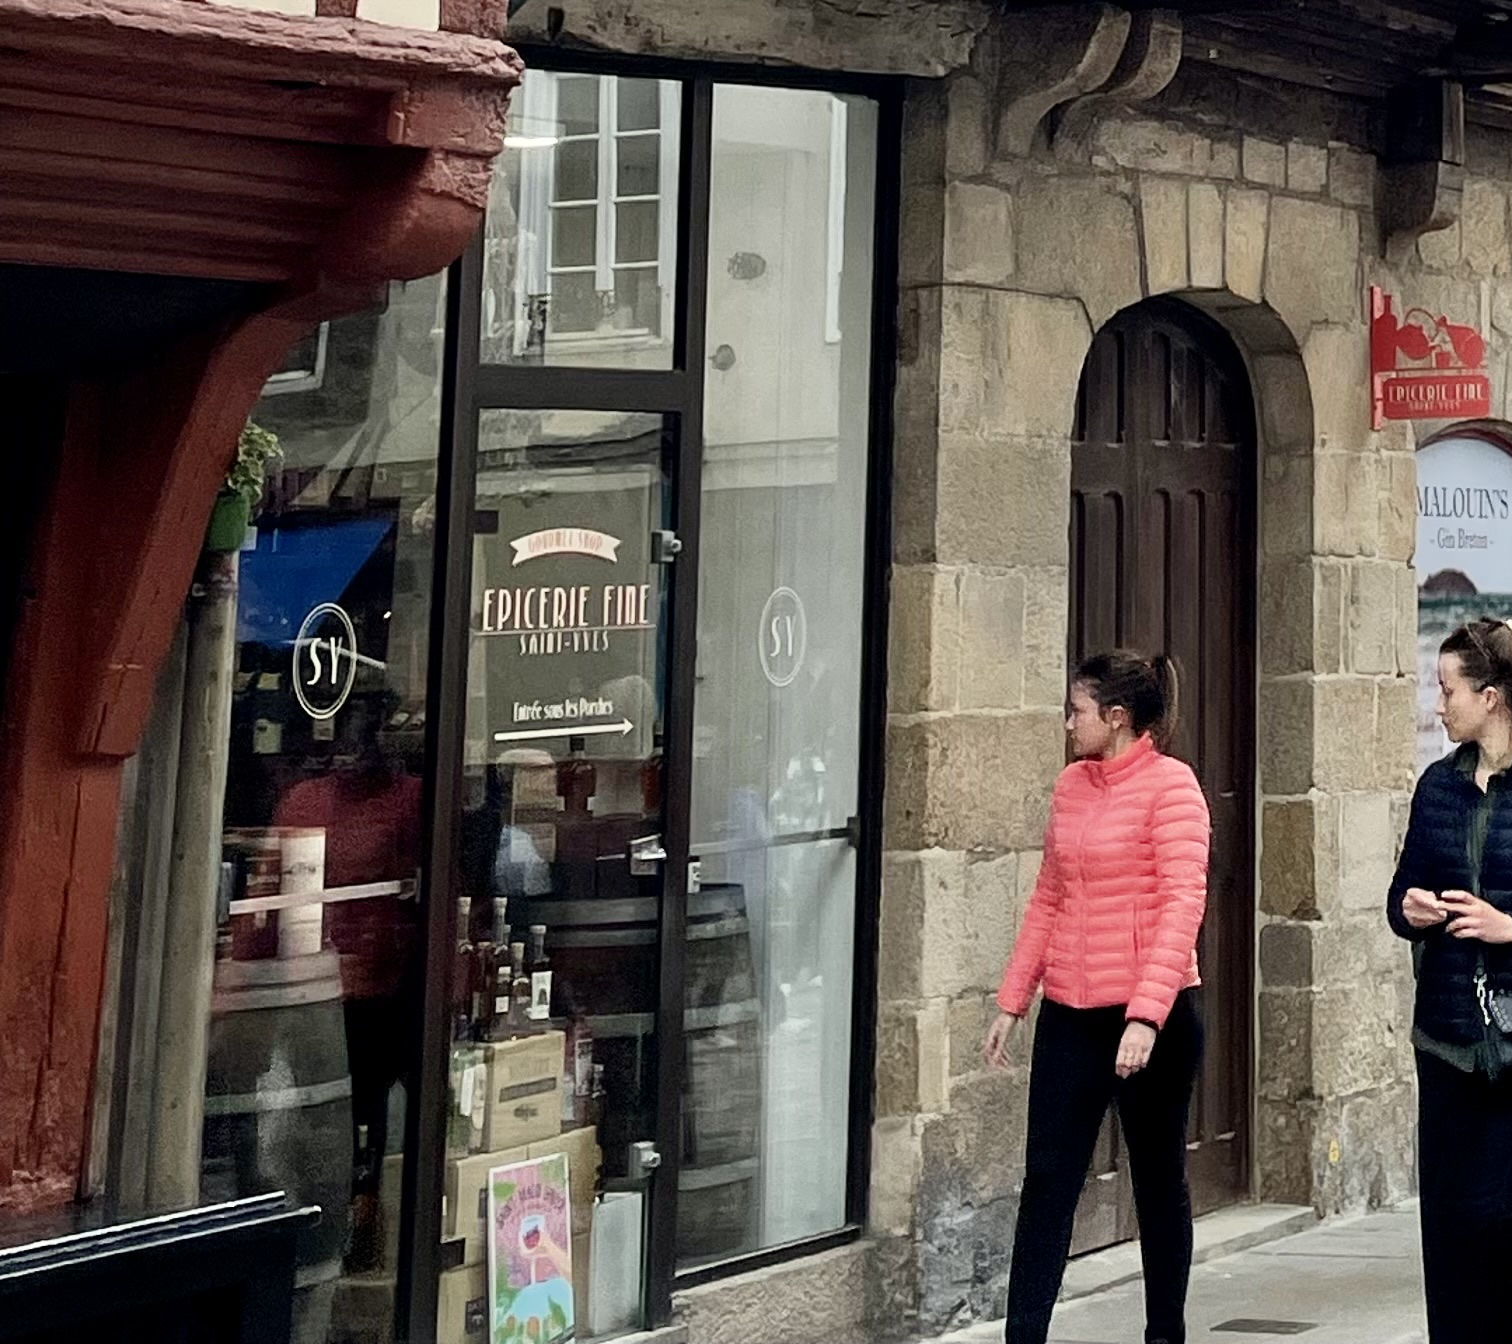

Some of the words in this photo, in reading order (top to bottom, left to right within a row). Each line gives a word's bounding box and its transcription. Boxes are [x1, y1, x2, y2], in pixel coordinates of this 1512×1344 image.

[1389, 384, 1448, 403] EPICERIE
[482, 586, 591, 632] EPICERIE
[603, 584, 650, 626] FINE
[519, 629, 610, 657] SAINT-YVES
[770, 615, 797, 657] SY
[306, 636, 343, 686] SY
[513, 698, 543, 724] Entrée
